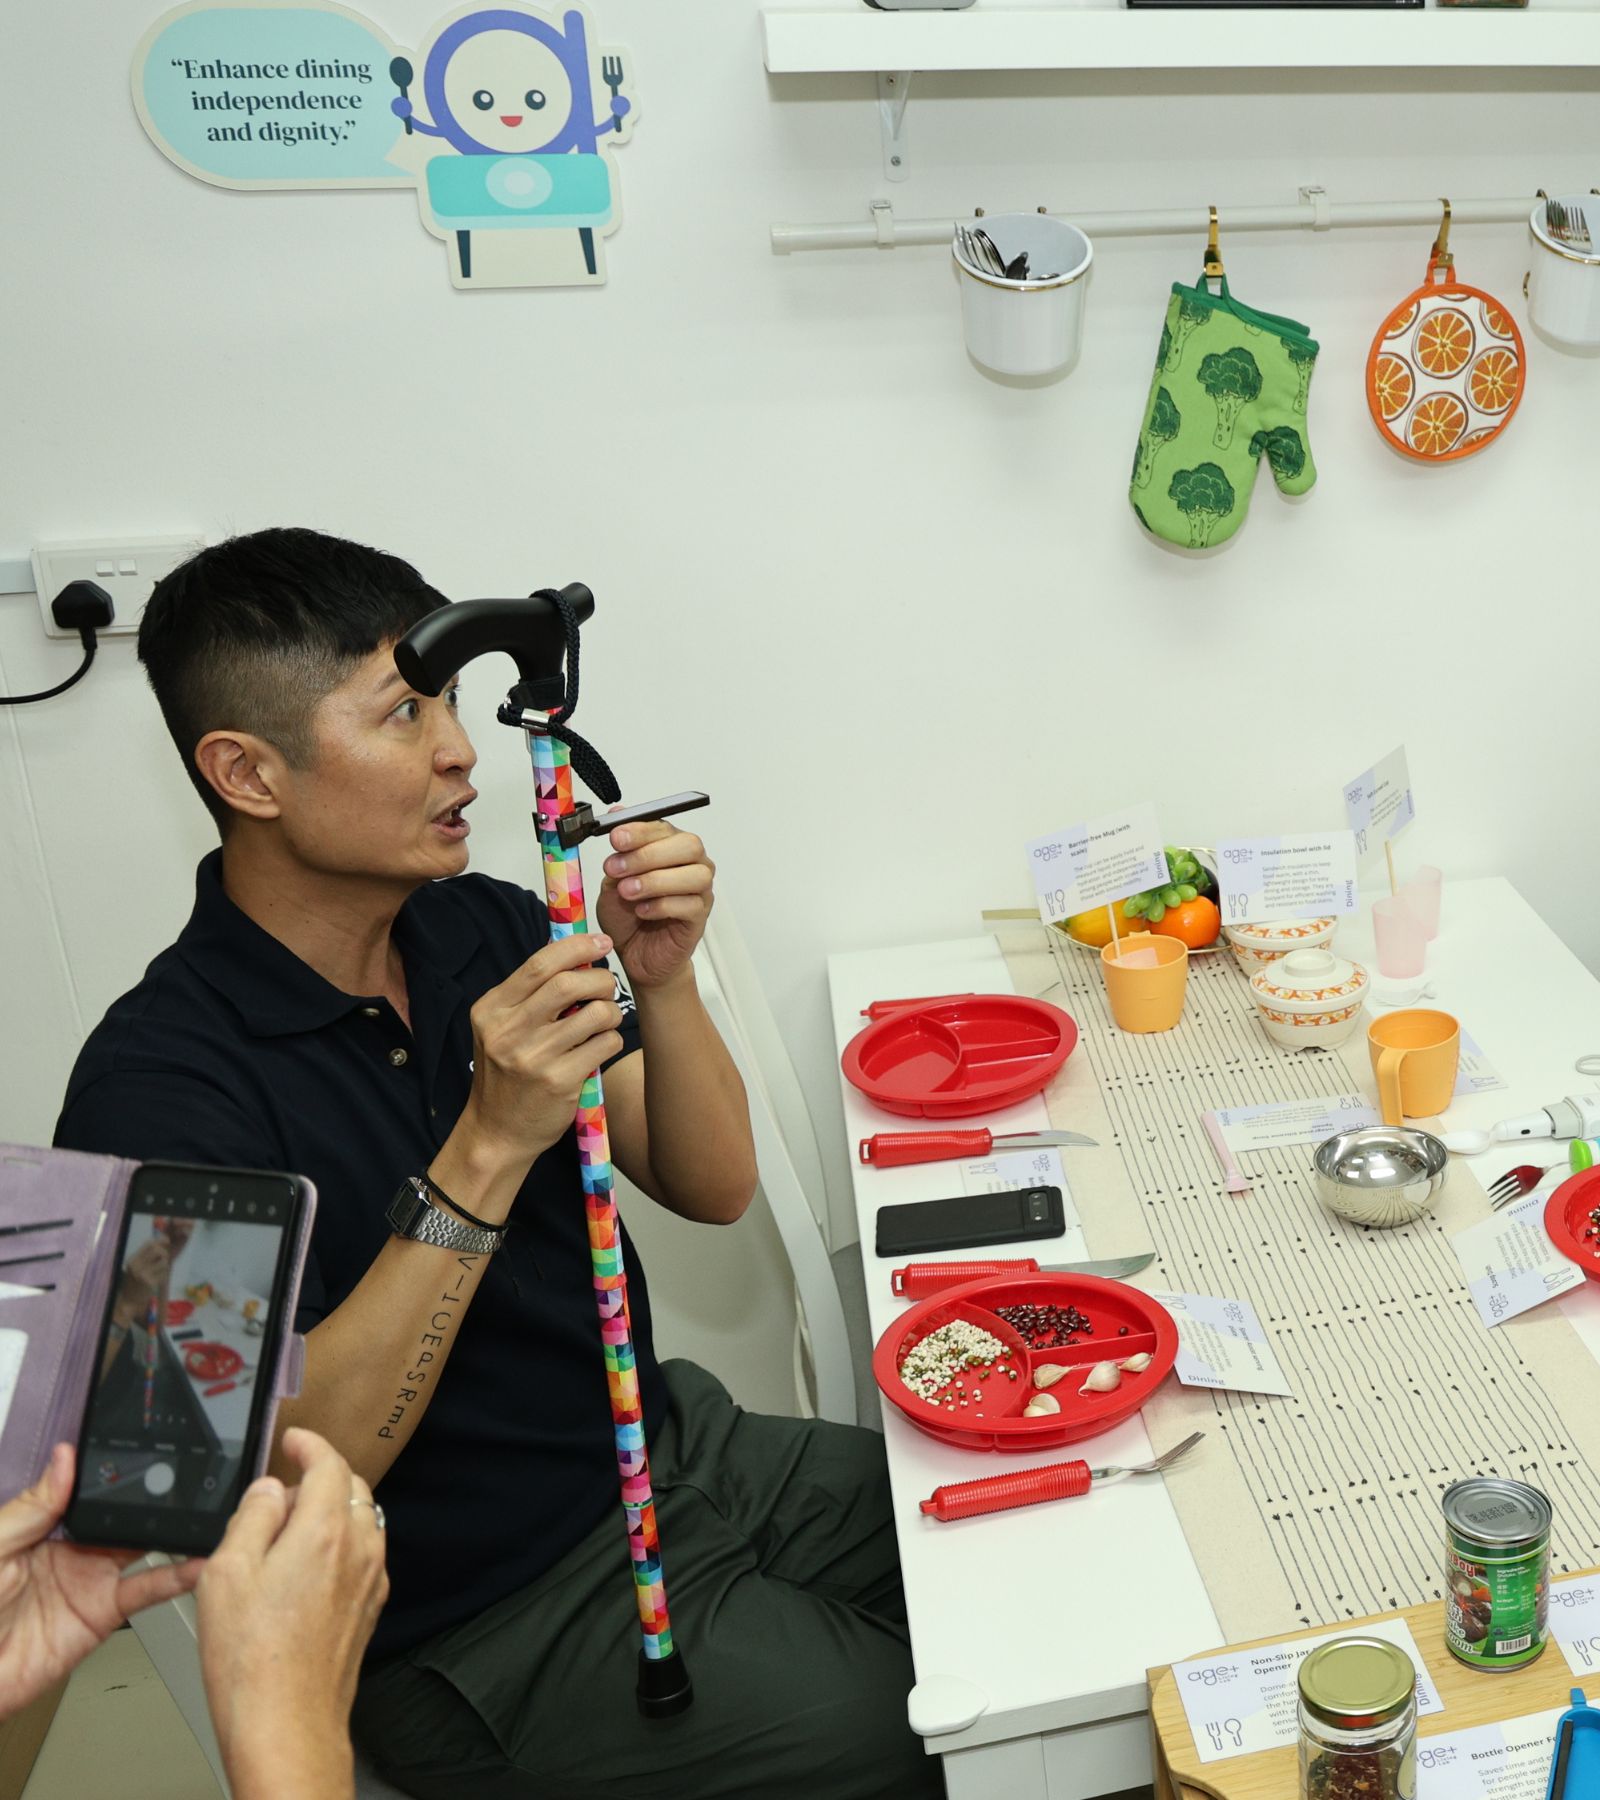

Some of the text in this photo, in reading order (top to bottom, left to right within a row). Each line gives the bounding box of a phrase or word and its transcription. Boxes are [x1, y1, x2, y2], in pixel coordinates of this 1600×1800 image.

[170, 58, 372, 84] “Enhance dining
[191, 90, 362, 116] independence
[207, 120, 356, 147] and dignity.”
[1068, 824, 1130, 849] Barrier-free Mug (with
[1033, 843, 1062, 862] age+
[1223, 848, 1253, 864] age+
[1153, 851, 1164, 879] Dining
[1345, 879, 1353, 907] Dining
[1507, 1199, 1539, 1217] Dining
[1489, 1292, 1509, 1318] age+
[1188, 1375, 1226, 1386] Dining
[1449, 1552, 1475, 1579] Boy
[1548, 1588, 1594, 1608] age+
[1251, 1649, 1310, 1666] Non-Slip Jar
[1188, 1665, 1239, 1686] age+
[1254, 1663, 1292, 1675] Opener
[1260, 1681, 1297, 1693] Dome-s
[1263, 1689, 1298, 1702] comfort
[1266, 1702, 1281, 1710] the
[1269, 1709, 1288, 1718] with
[1272, 1717, 1298, 1726] sensa
[1274, 1727, 1298, 1736] uppe
[1417, 1745, 1457, 1768] ge+
[1471, 1748, 1504, 1760] Bottle
[1505, 1739, 1544, 1753] Opener
[1478, 1766, 1504, 1776] Saves
[1505, 1761, 1525, 1771] time
[1527, 1756, 1545, 1766] and
[1482, 1766, 1549, 1786] for people with
[1486, 1780, 1524, 1795] strength
[1519, 1787, 1536, 1798] cap
